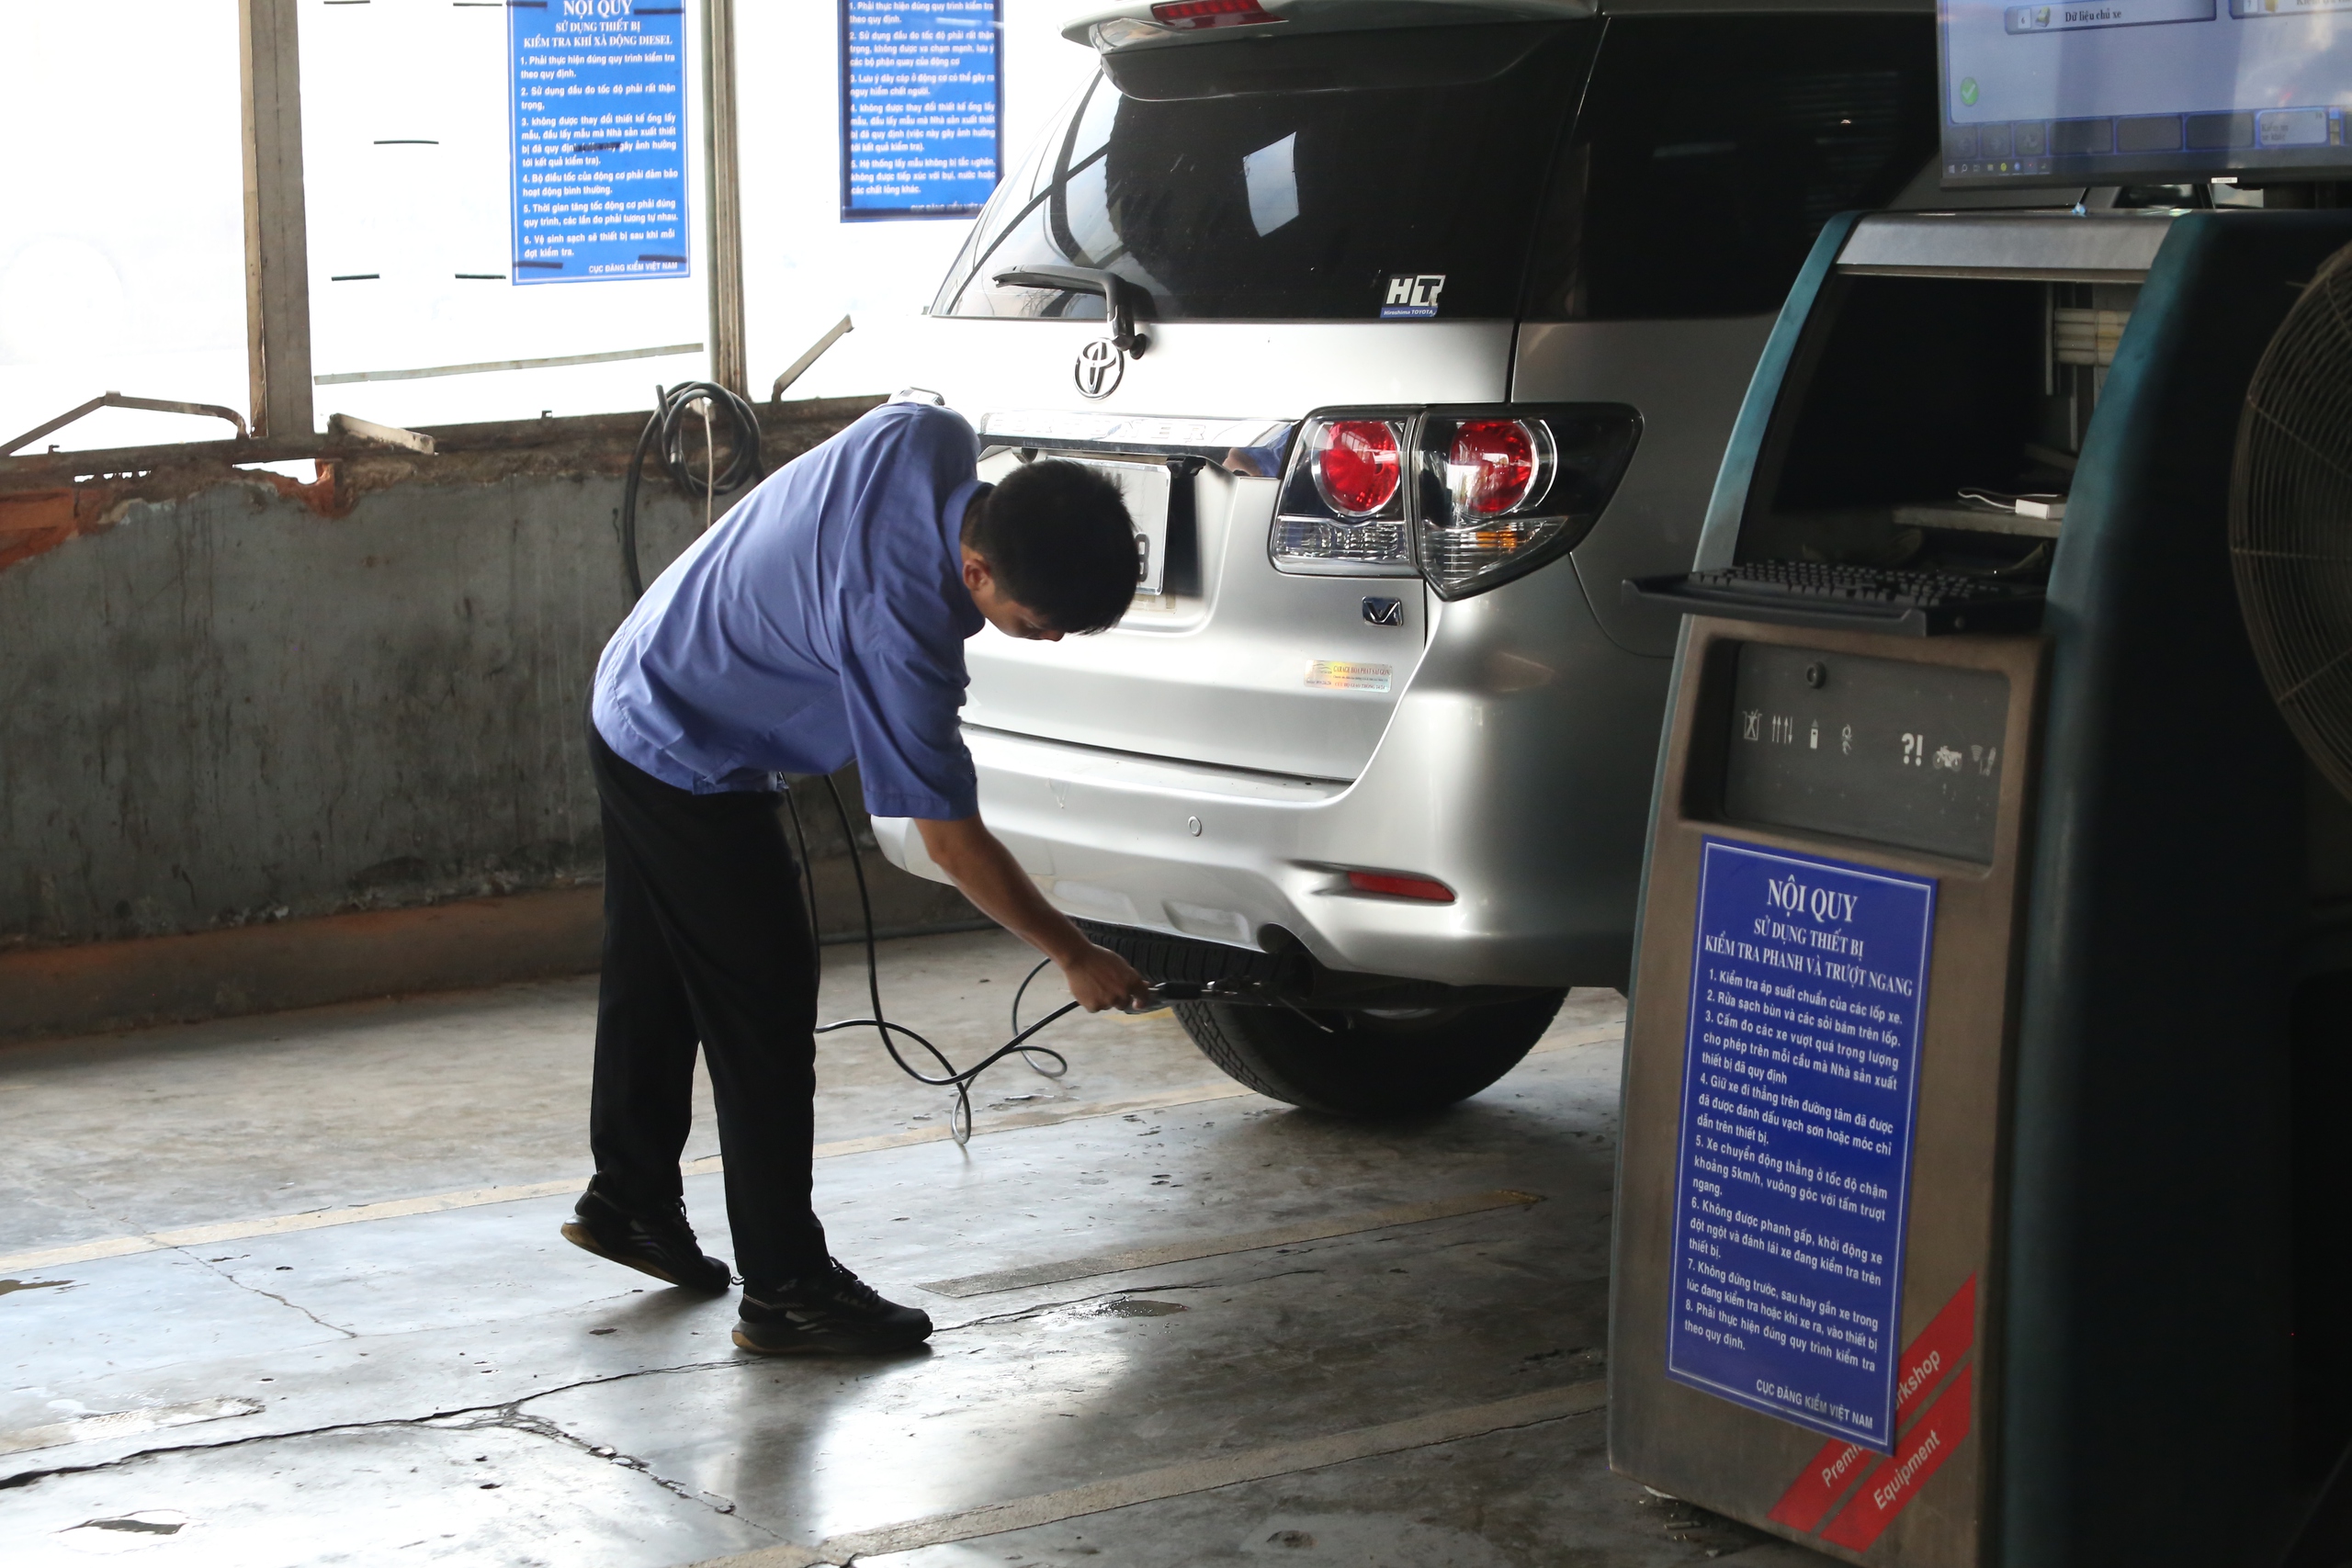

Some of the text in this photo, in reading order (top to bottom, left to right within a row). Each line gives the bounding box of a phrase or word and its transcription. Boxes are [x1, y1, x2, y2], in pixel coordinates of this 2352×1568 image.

[597, 0, 632, 18] QUY
[639, 35, 673, 45] DIESEL
[1767, 874, 1858, 922] NỘI QUY
[1705, 931, 1913, 997] KIỂM TRA PHANH VÀ TRƯỢT NGANG
[1754, 915, 1864, 961] SỬ DỤNG THIẾT BỊ
[1707, 989, 1901, 1048] 2. Rửa sạch bùn và các sỏi bám trên lốp.
[1710, 968, 1903, 1024] 1. Kiểm tra áp suất chuẩn của các lốp xe.
[1703, 1032, 1897, 1090] cho phép trên mỗi cầu mà Nhà sản xuất
[1705, 1010, 1899, 1071] 3. Cấm đo các xe vượt quá trọng lượng
[1696, 1134, 1887, 1200] 5. Xe chuyển động thẳng ở tốc độ chậm
[1685, 1319, 1746, 1350] theo quy định.
[1685, 1299, 1875, 1371] 8. Phải thực hiện đúng quy trình kiểm tra
[1756, 1379, 1873, 1429] CỤC ĐĂNG KIỂM VIỆT NAM
[1822, 1350, 1940, 1488] Premi rkshop
[1873, 1429, 1940, 1510] Equipment
